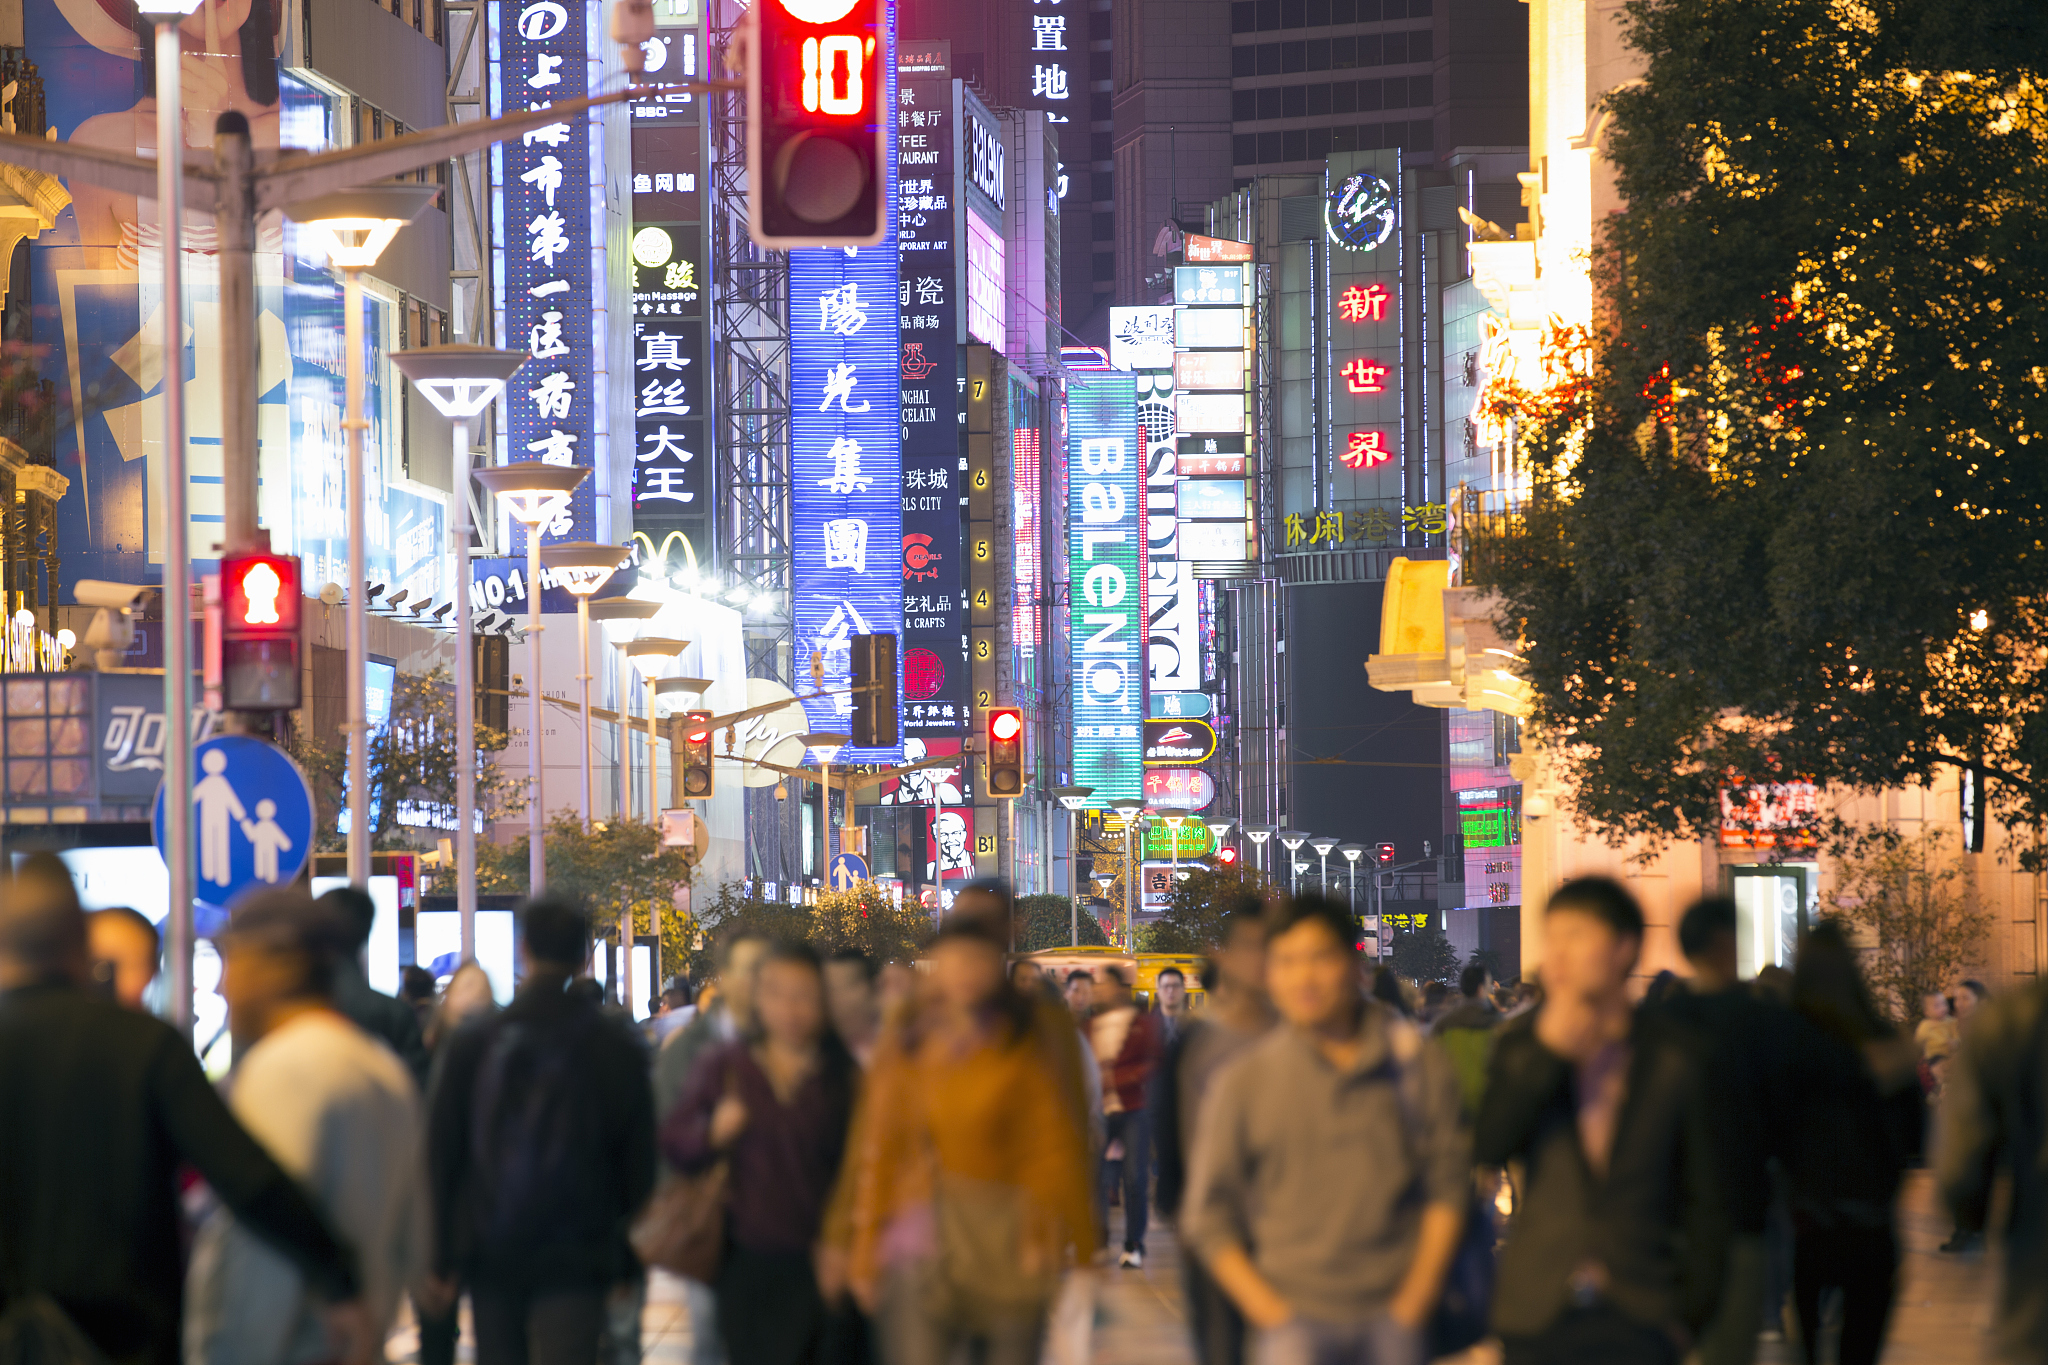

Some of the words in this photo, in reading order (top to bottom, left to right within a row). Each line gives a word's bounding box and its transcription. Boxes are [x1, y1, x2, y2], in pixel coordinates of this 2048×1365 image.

[803, 35, 863, 114] 10
[899, 88, 914, 105] 景
[636, 106, 667, 118] BBQ
[634, 173, 695, 193] 鱼网咖
[933, 241, 947, 249] ART
[1187, 234, 1223, 261] 新世界
[652, 292, 697, 302] Massage
[900, 315, 940, 330] 品商场
[1339, 284, 1388, 468] 新世界
[974, 381, 983, 398] 7
[636, 331, 694, 502] 真丝大王
[902, 408, 936, 423] CELAIN
[1181, 466, 1192, 474] 3F
[1198, 460, 1241, 473] 干锅居
[901, 468, 948, 489] 珠城
[976, 470, 987, 486] 6
[1182, 484, 1193, 492] 3F
[919, 497, 941, 511] CITY
[1284, 502, 1447, 547] 休闲港湾
[977, 541, 987, 558] 5
[468, 568, 525, 613] NO.1
[976, 590, 988, 607] 4
[903, 595, 951, 612] 艺礼品
[914, 617, 945, 629] CRAFTS
[977, 641, 988, 658] 3
[979, 690, 989, 707] 2
[925, 719, 955, 727] Jewelers
[1146, 775, 1203, 793] 干锅居
[978, 835, 995, 852] B1
